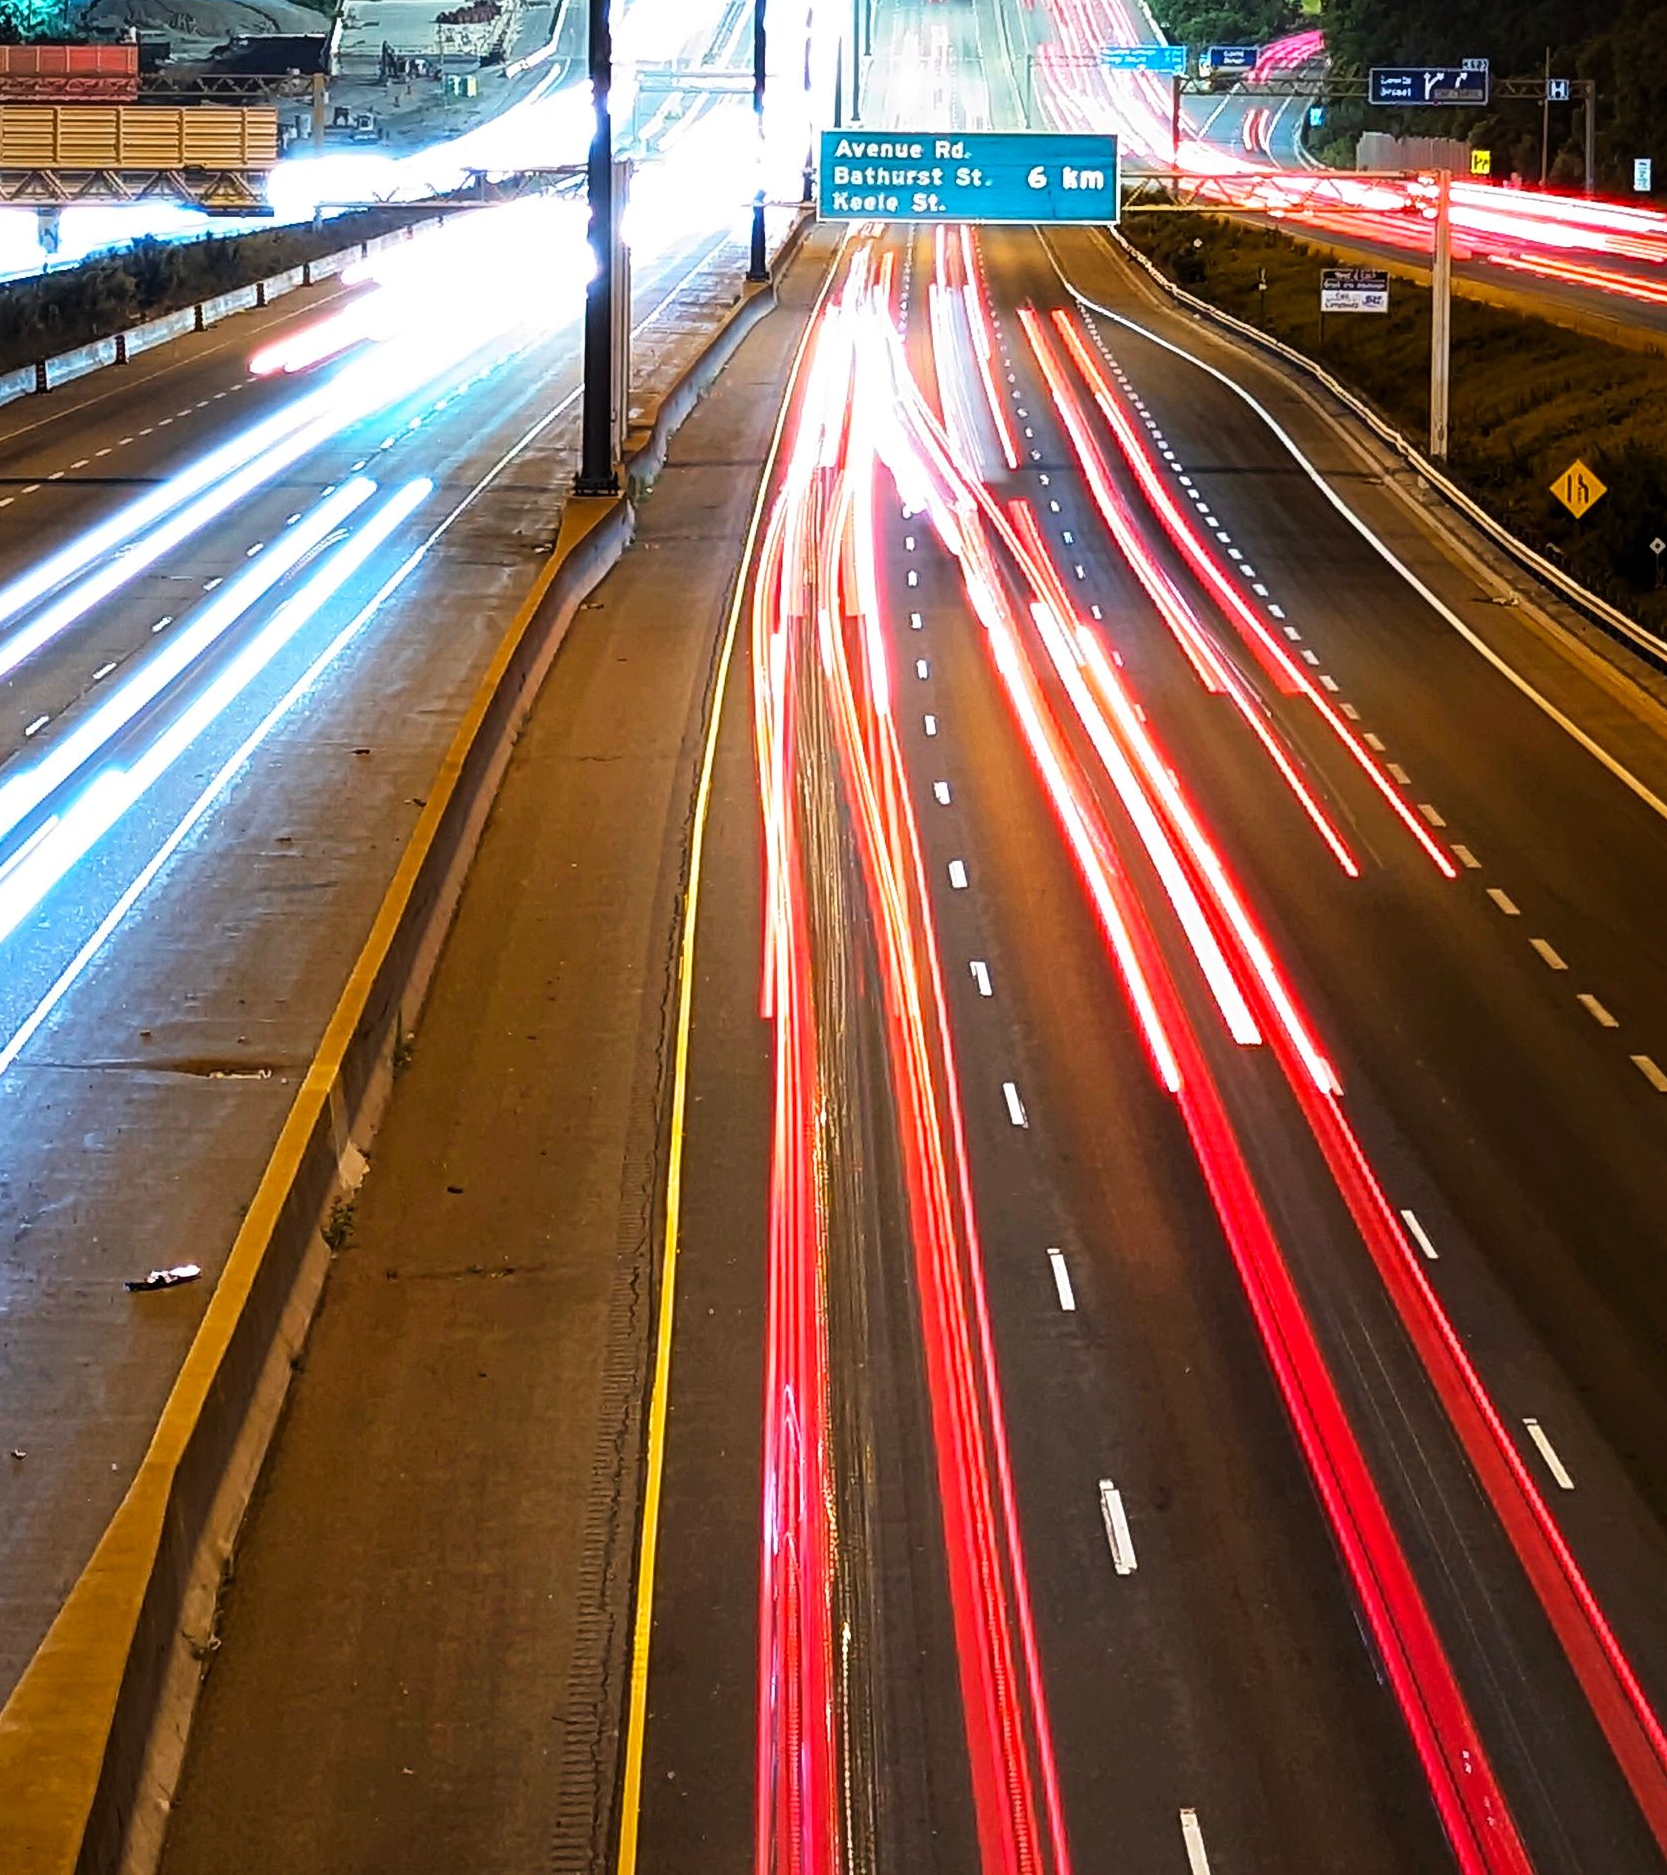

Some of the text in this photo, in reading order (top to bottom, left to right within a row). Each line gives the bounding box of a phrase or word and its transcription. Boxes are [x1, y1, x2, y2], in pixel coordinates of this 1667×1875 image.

[834, 139, 972, 159] Avenue Rd.
[833, 166, 993, 187] Bathurst St.
[1027, 166, 1104, 190] 6 km
[832, 191, 946, 212] Keele St.
